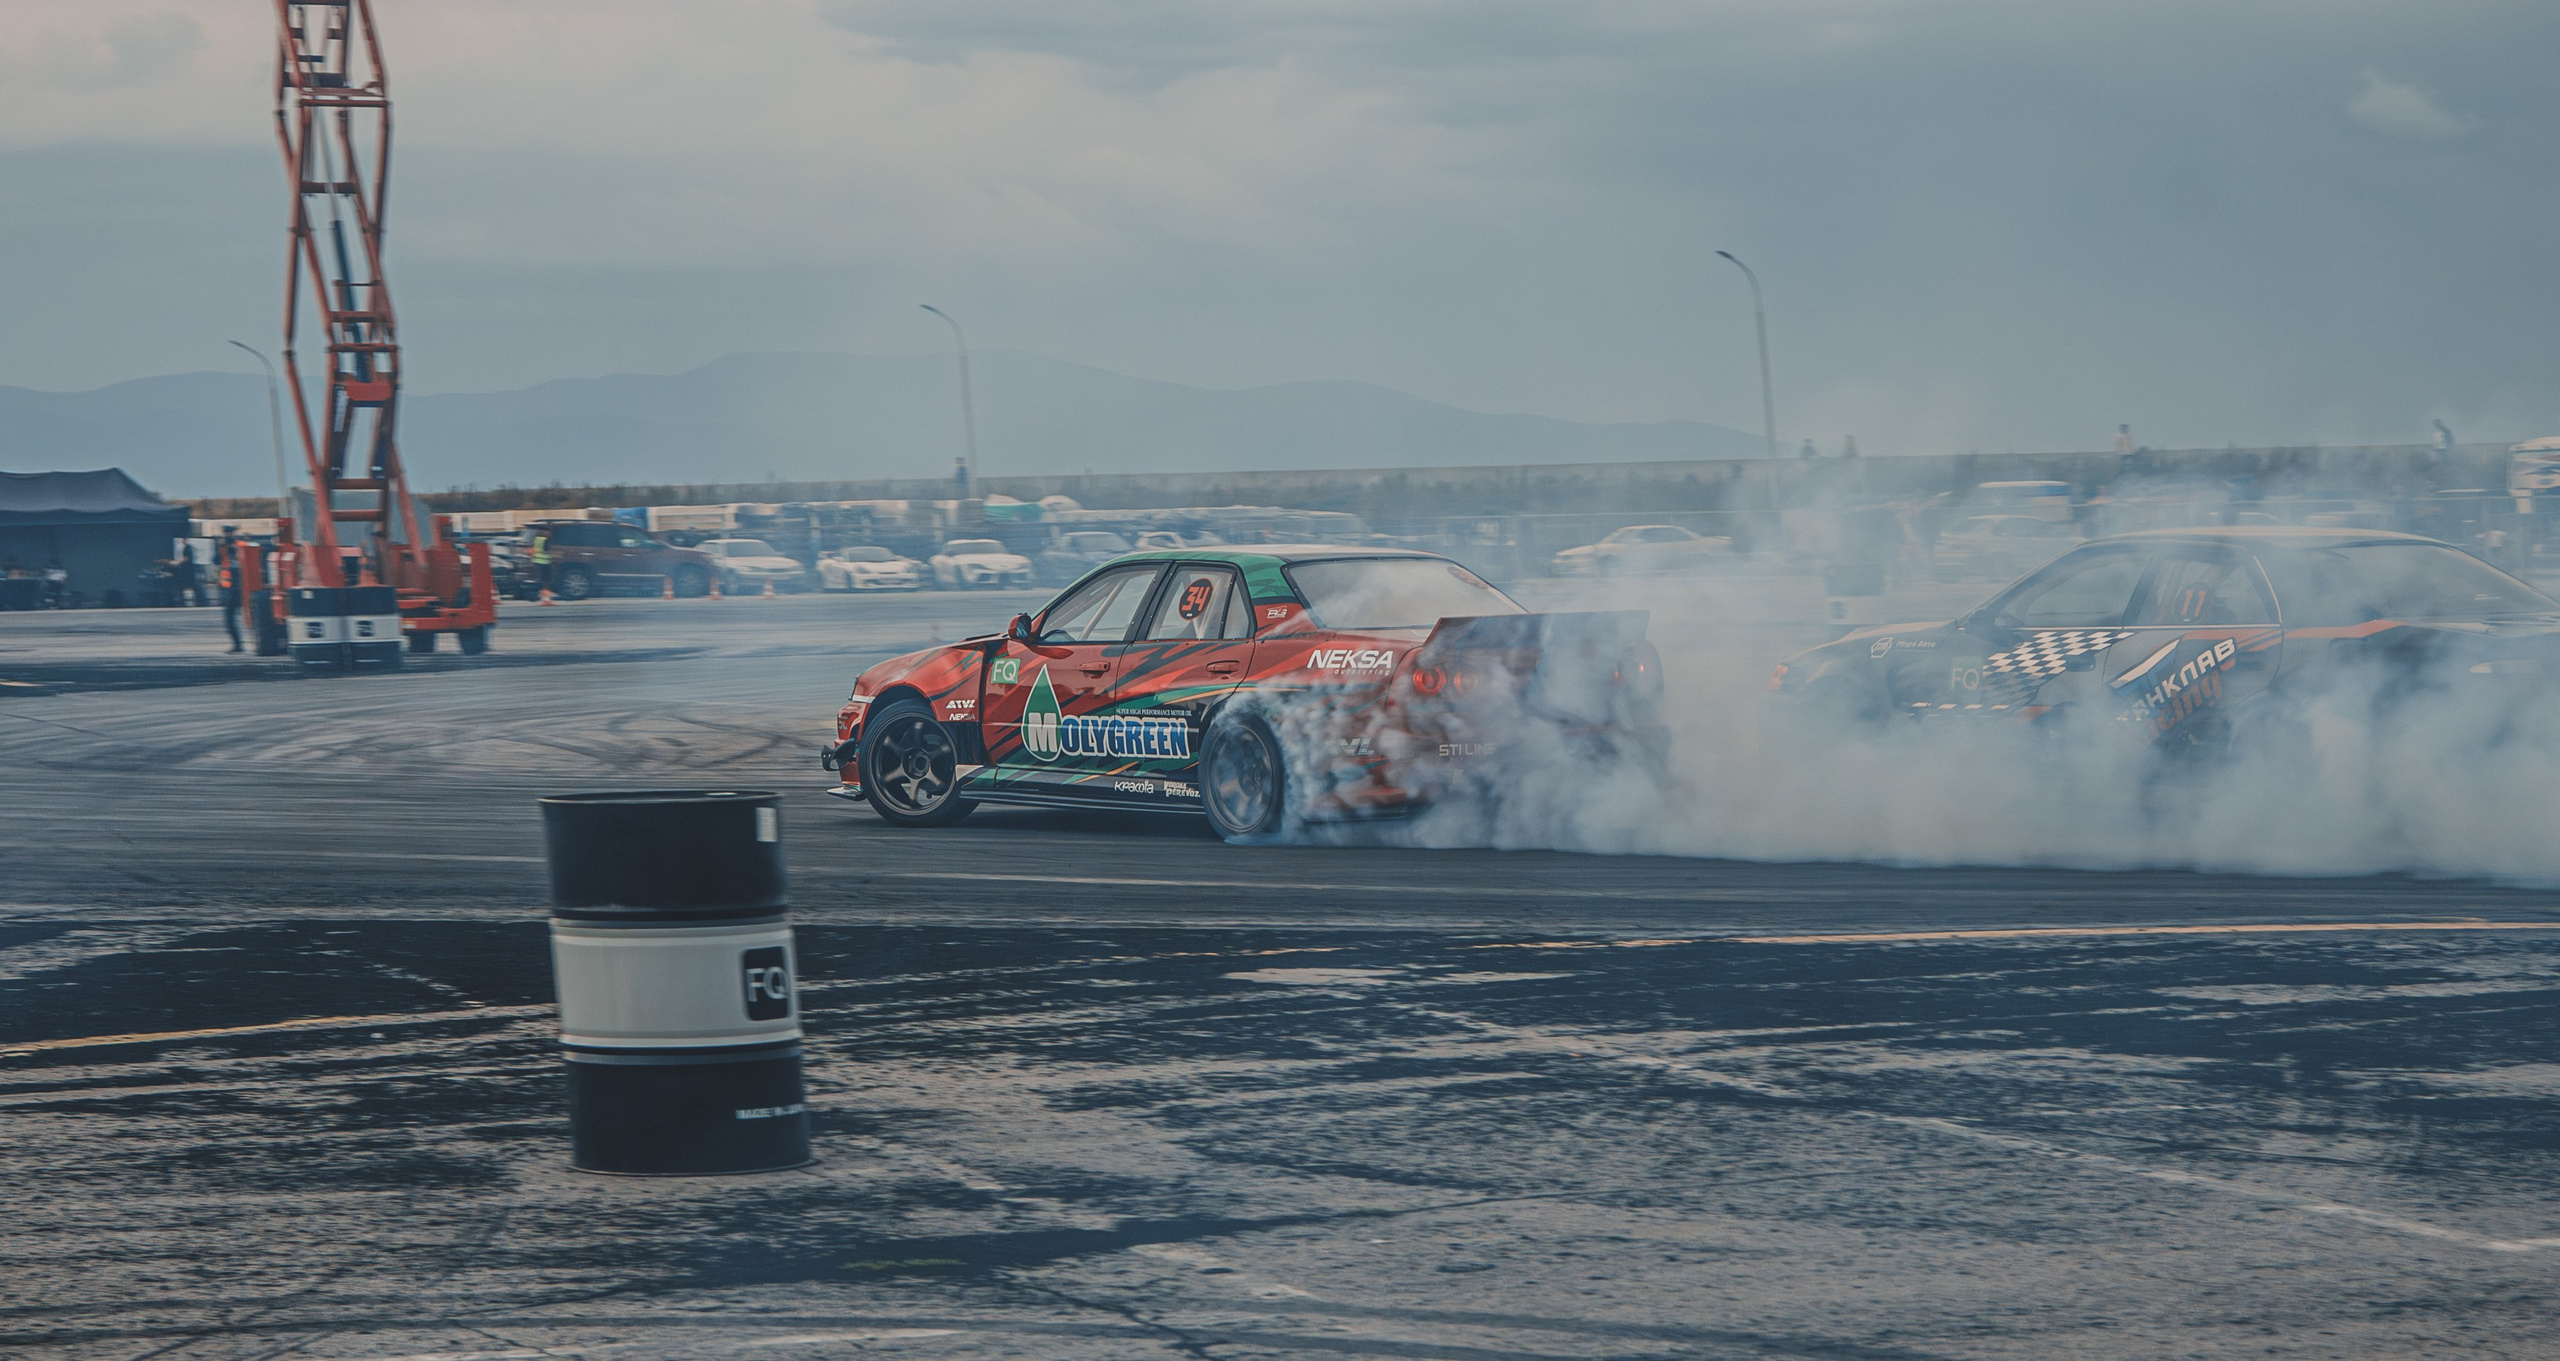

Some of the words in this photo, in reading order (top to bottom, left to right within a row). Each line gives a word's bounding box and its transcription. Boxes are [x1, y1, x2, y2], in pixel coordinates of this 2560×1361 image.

[1181, 586, 1211, 611] 34
[2180, 589, 2207, 617] 11
[993, 660, 1017, 682] FQ
[1306, 649, 1394, 669] NEKSA
[1951, 667, 1980, 690] FQ
[949, 713, 976, 721] NEKSA
[1028, 712, 1191, 760] MOLYGREEN
[746, 966, 790, 1003] FQ
